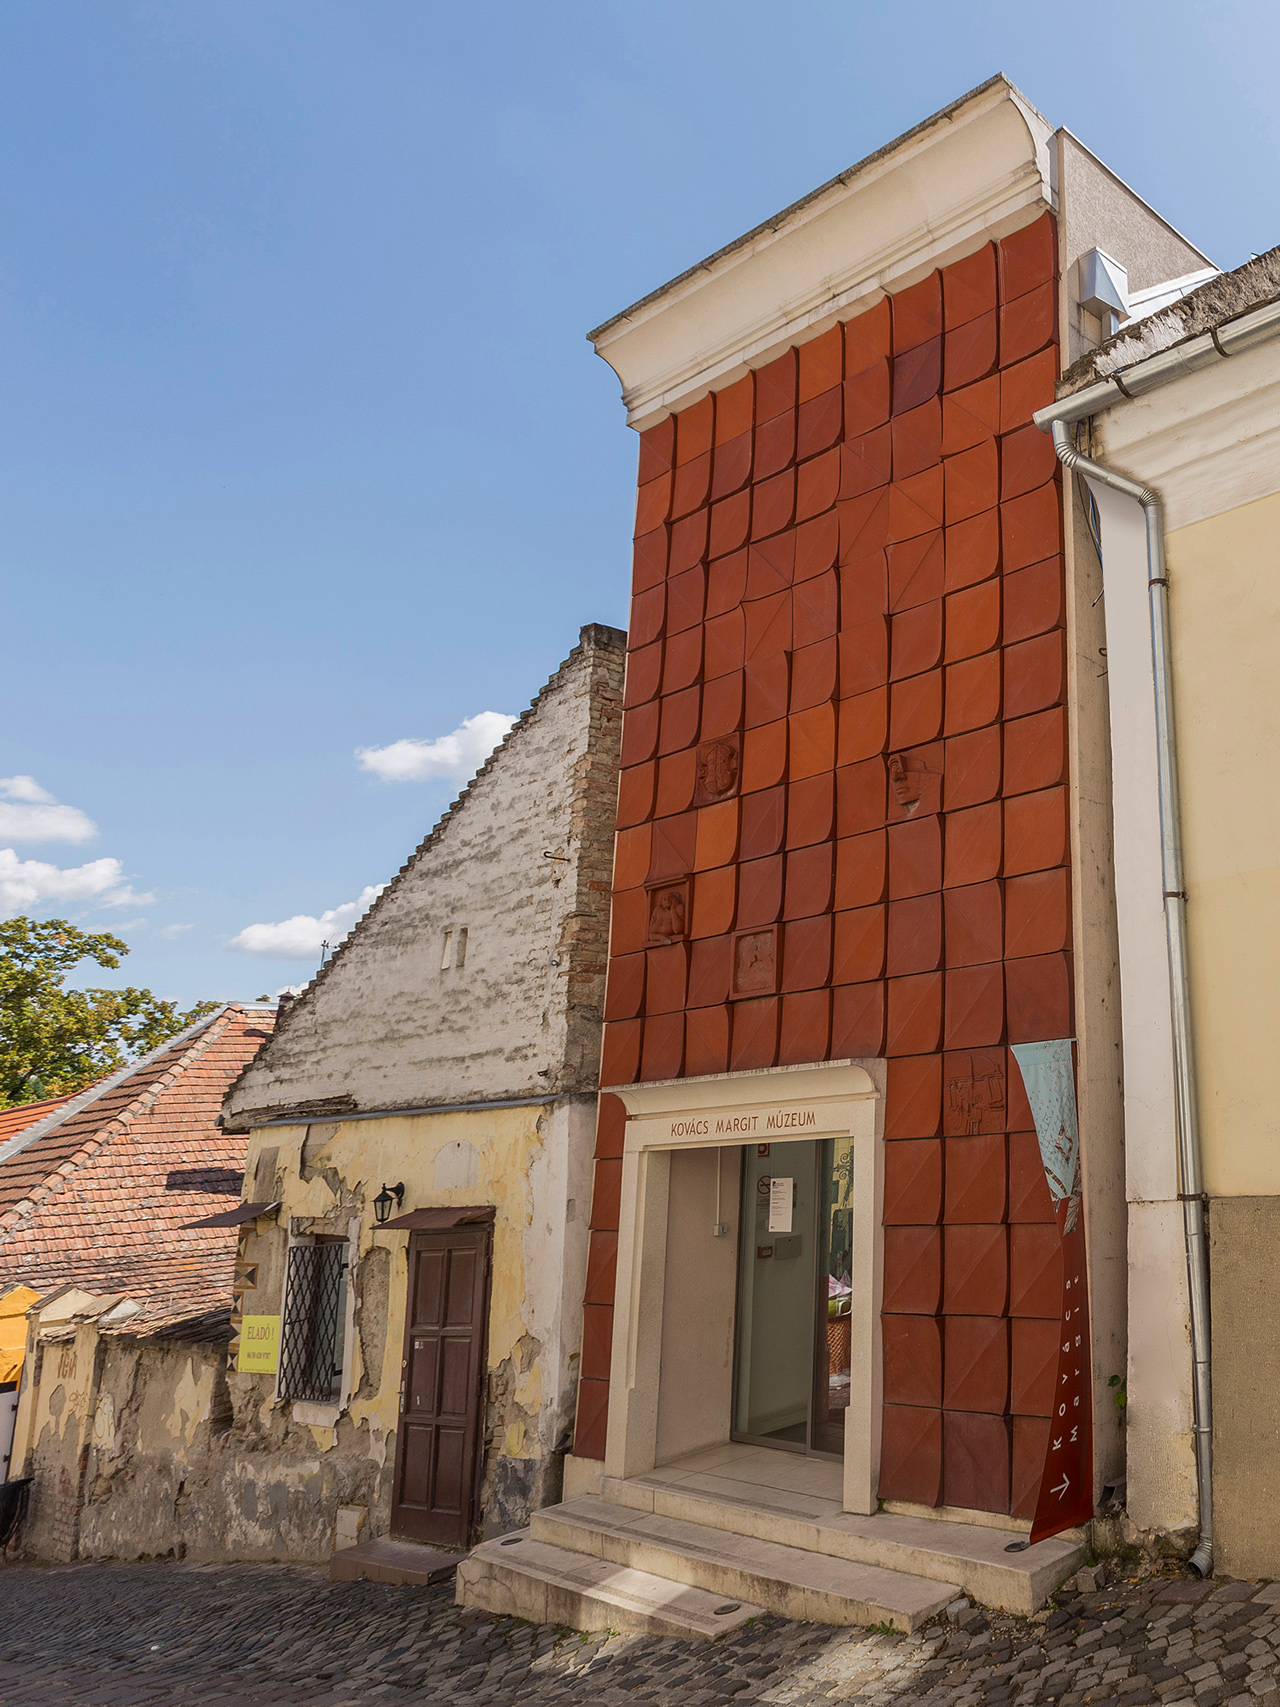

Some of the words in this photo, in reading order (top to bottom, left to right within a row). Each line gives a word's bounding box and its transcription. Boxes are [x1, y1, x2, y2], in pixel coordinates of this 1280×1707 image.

[671, 1118, 709, 1137] KOVÁCS
[715, 1116, 759, 1133] MARGIT
[766, 1110, 816, 1129] MÚZEUM
